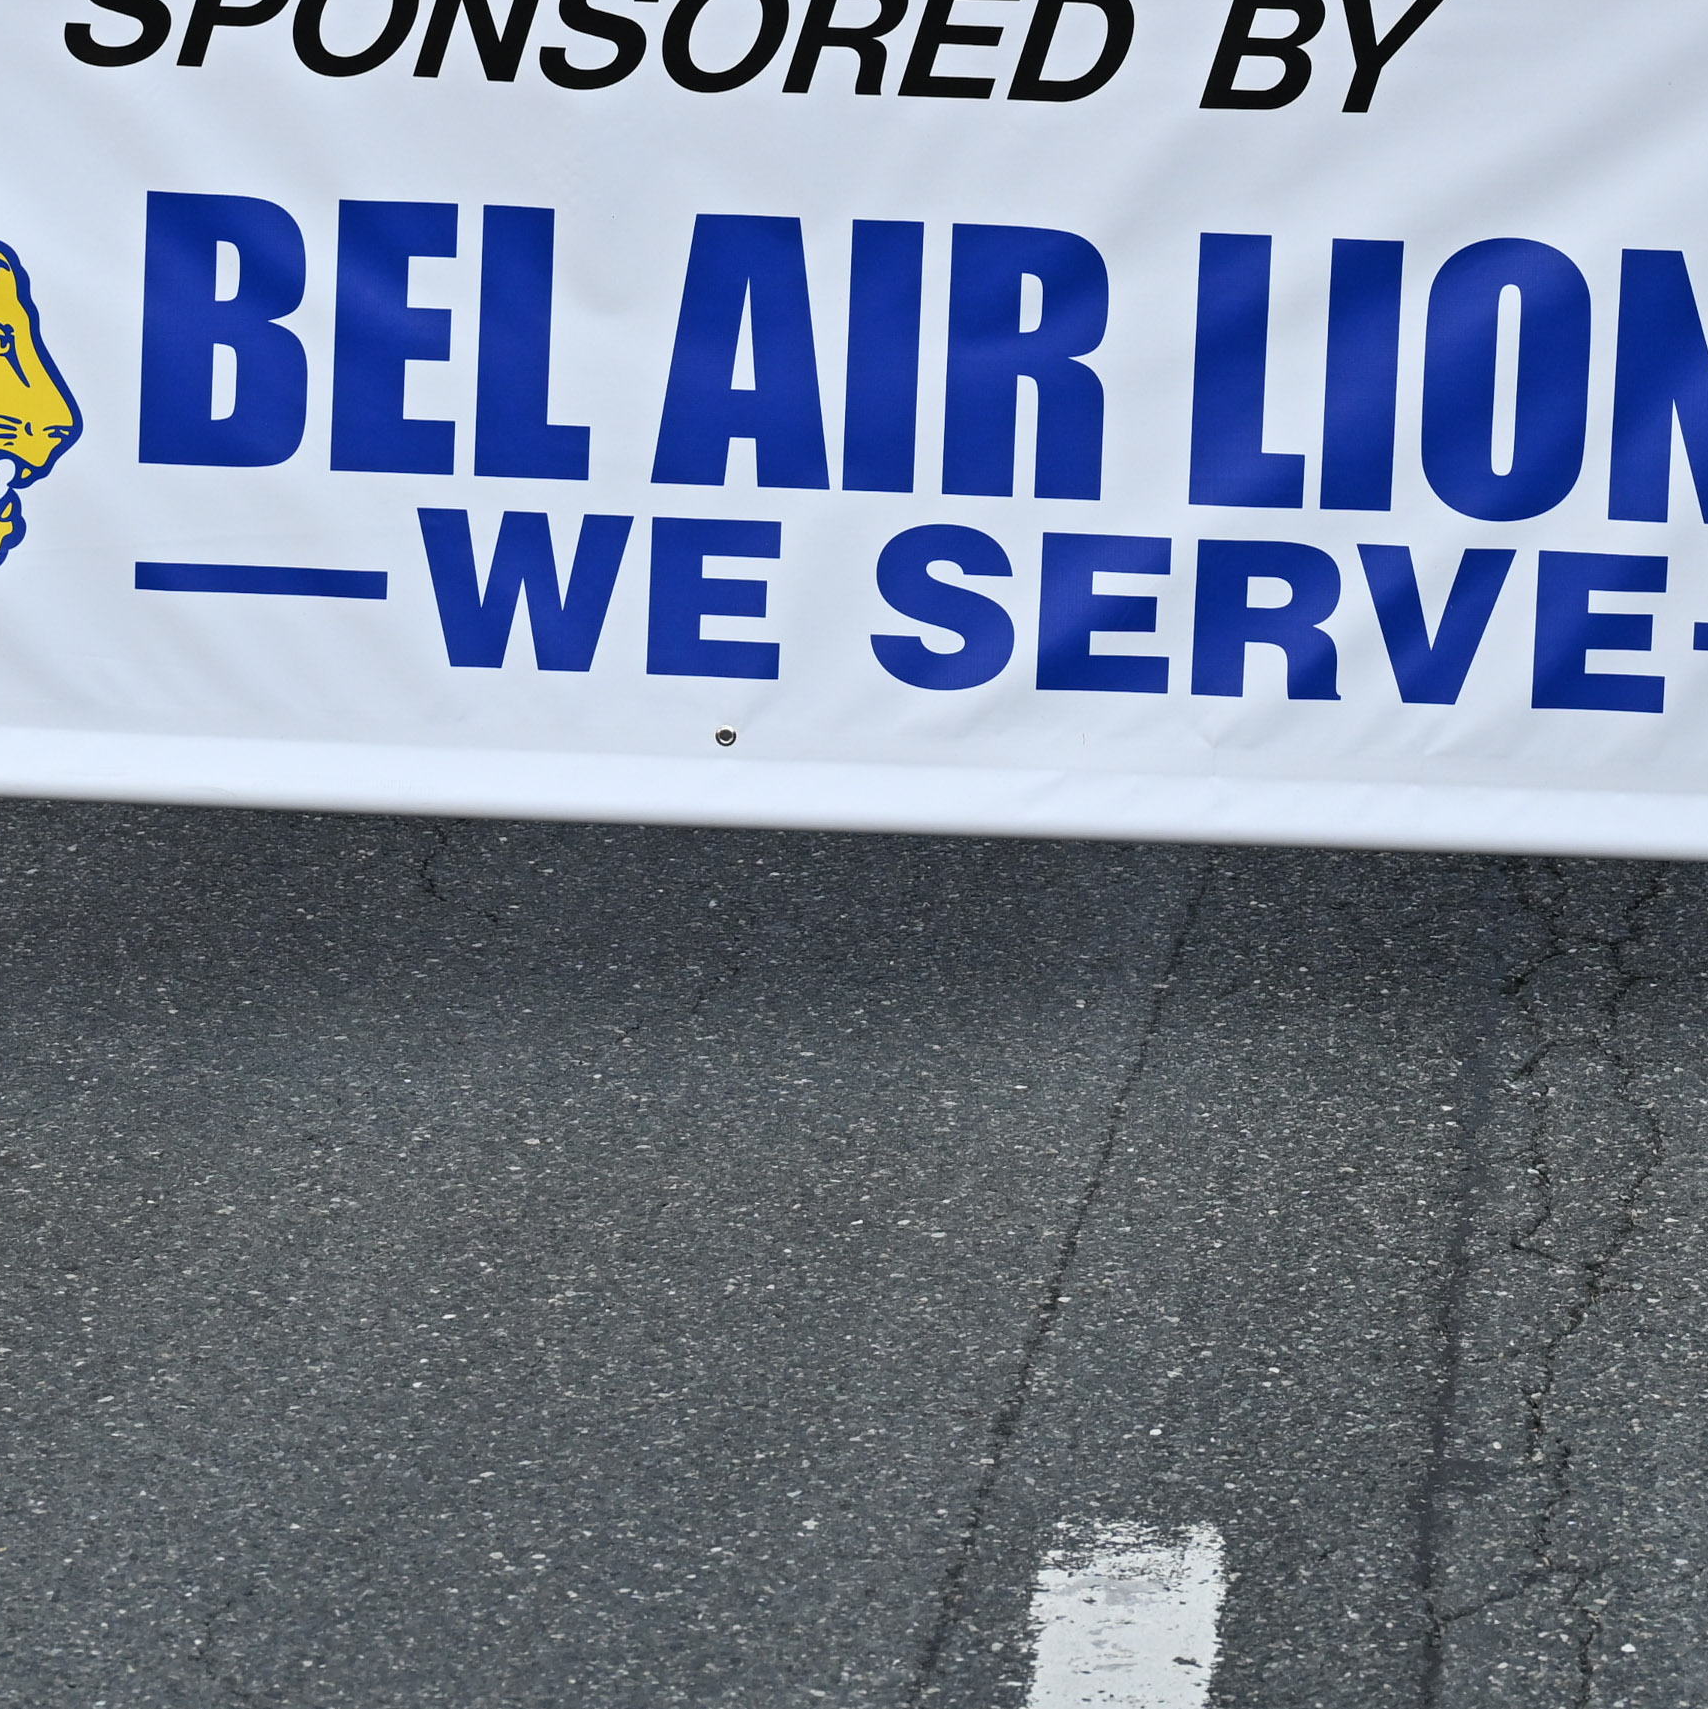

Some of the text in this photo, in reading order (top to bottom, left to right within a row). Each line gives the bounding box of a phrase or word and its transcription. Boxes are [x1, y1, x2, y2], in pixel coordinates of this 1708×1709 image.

[139, 191, 591, 481] BEL
[651, 214, 1110, 501] AIR
[417, 508, 1669, 714] WE SERVE
